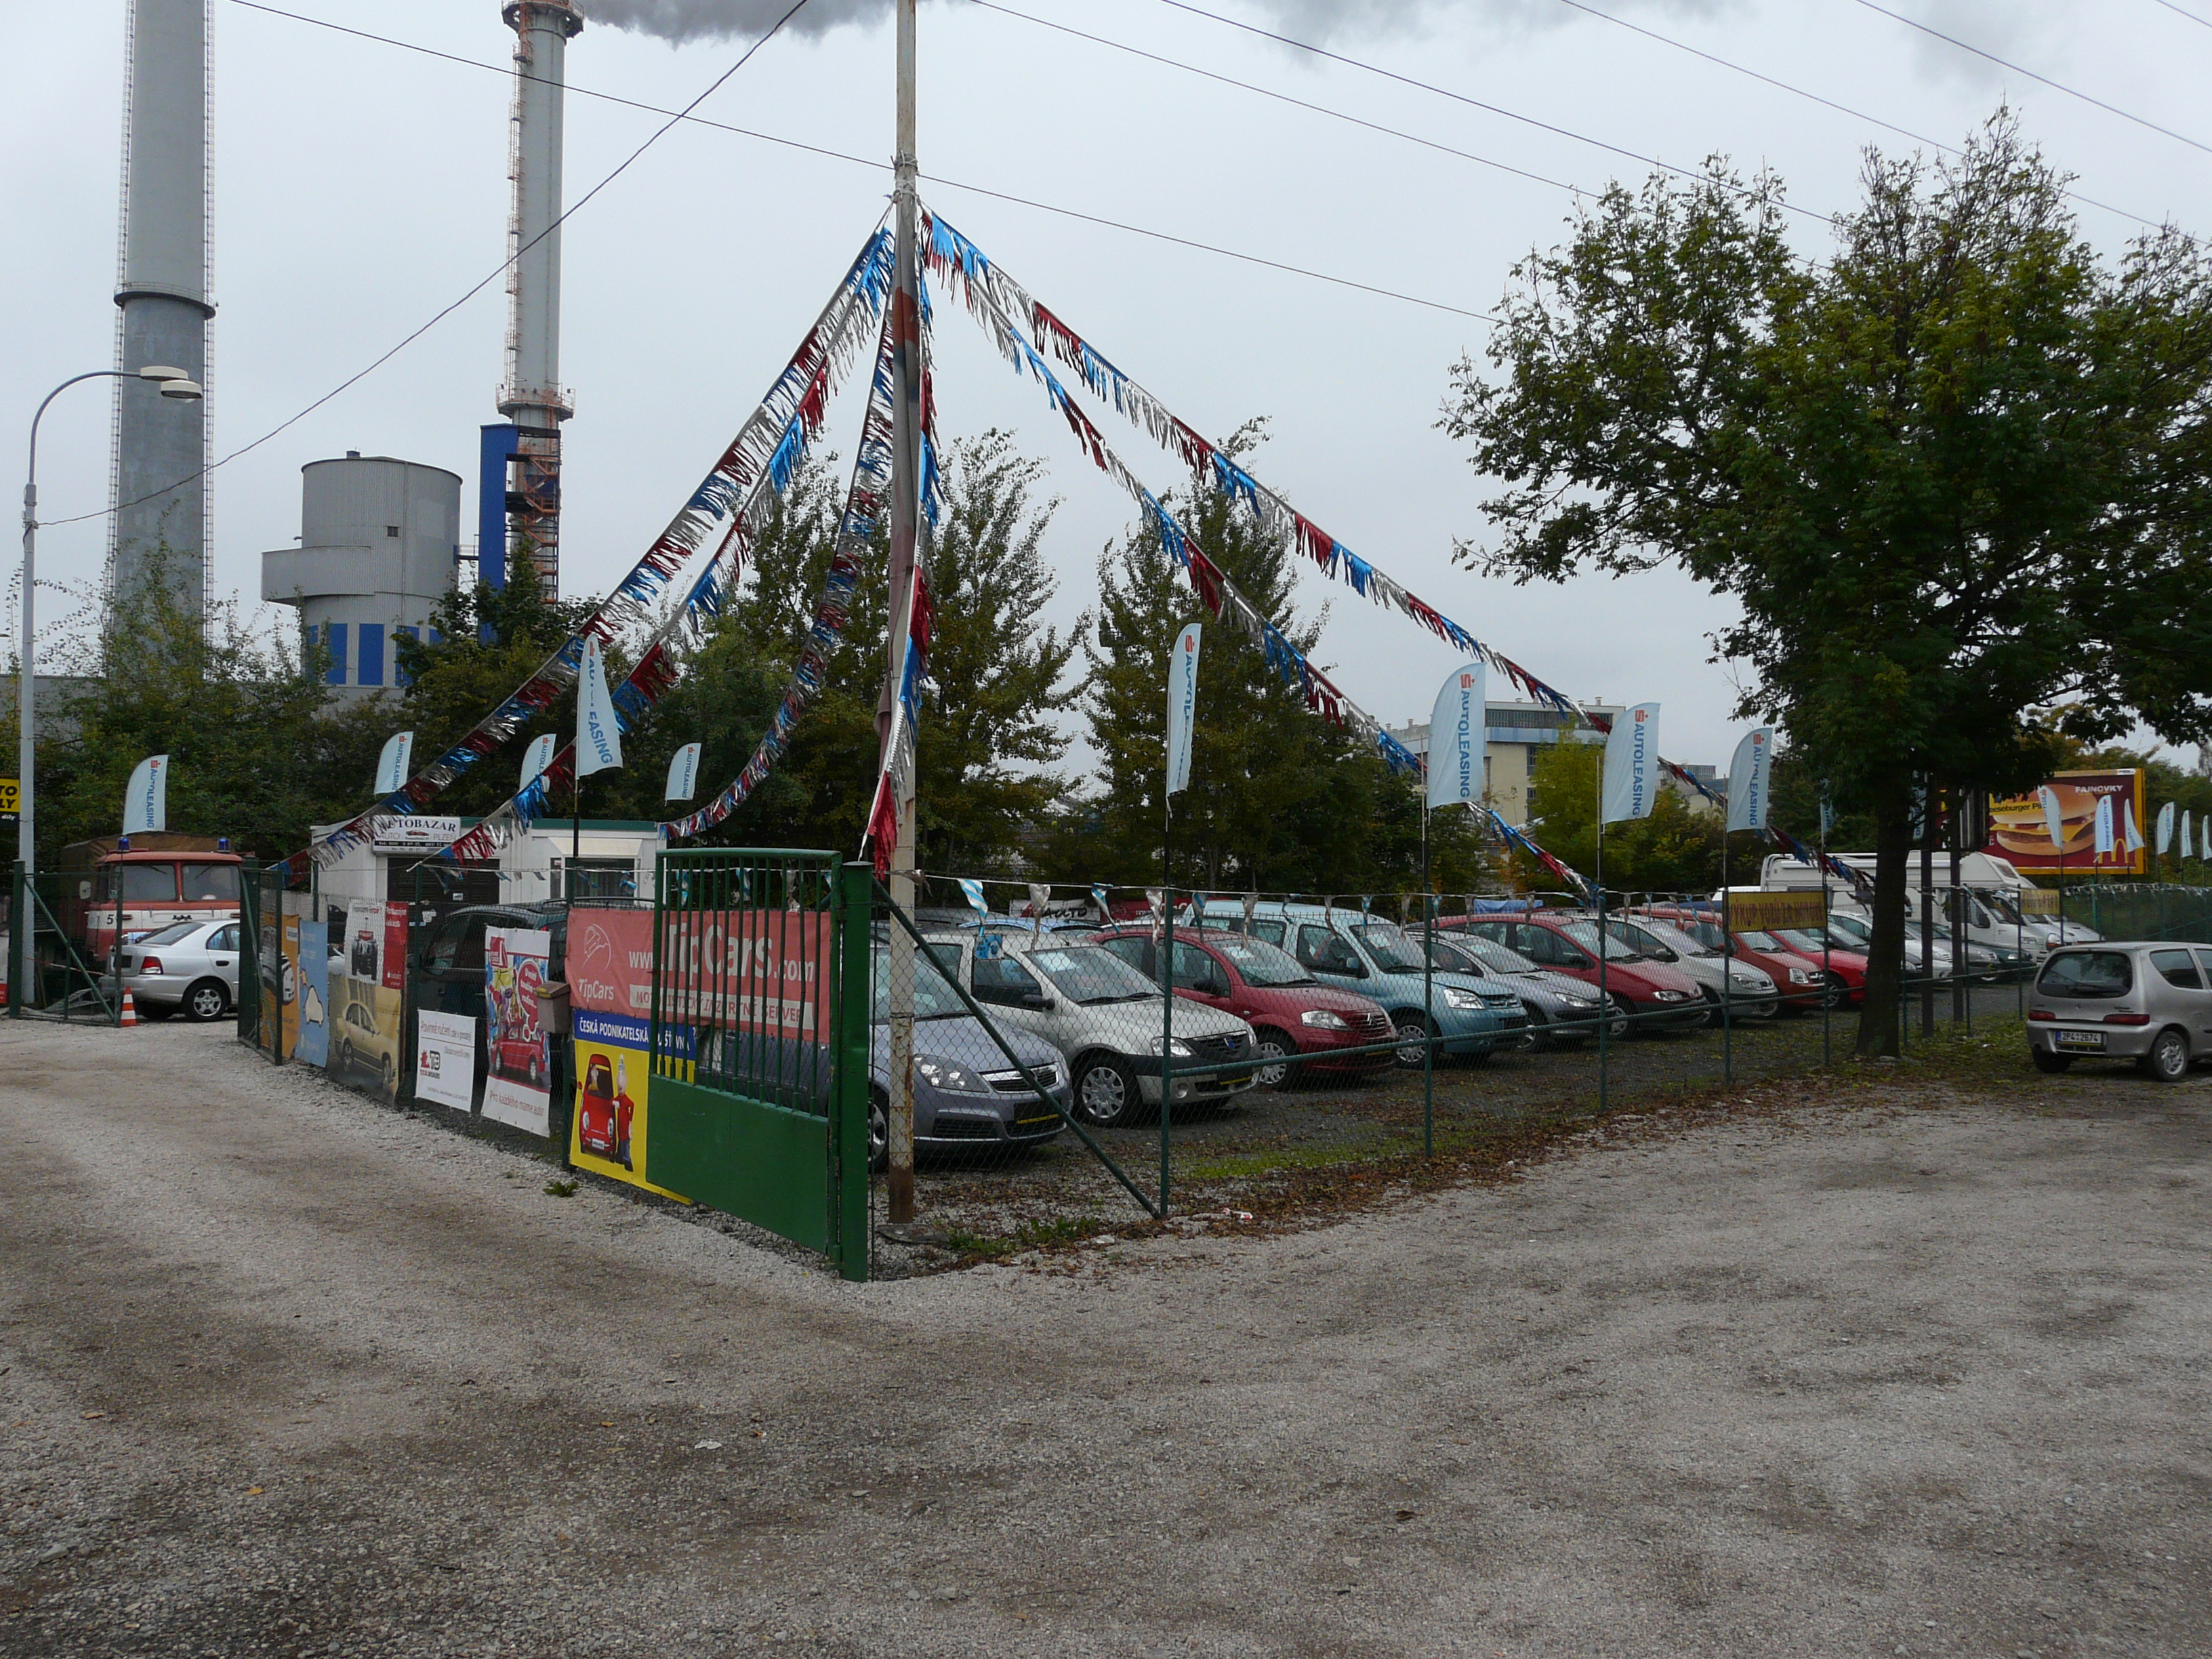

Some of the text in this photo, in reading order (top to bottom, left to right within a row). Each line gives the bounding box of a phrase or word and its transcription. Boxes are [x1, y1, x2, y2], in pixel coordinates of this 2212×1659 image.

[392, 743, 405, 790] AUTOLEASING
[1458, 690, 1470, 798] AUTOLEASING
[682, 754, 693, 798] AUTOLEASING
[1633, 724, 1644, 815] AUTOLEASING
[146, 769, 158, 828] AUTOLEASING
[579, 978, 614, 1002] TipCars
[579, 1017, 598, 1035] ČESKÁ
[599, 1023, 649, 1044] PODNIKATELSKÁ
[2062, 1031, 2098, 1042] 2P4 2674
